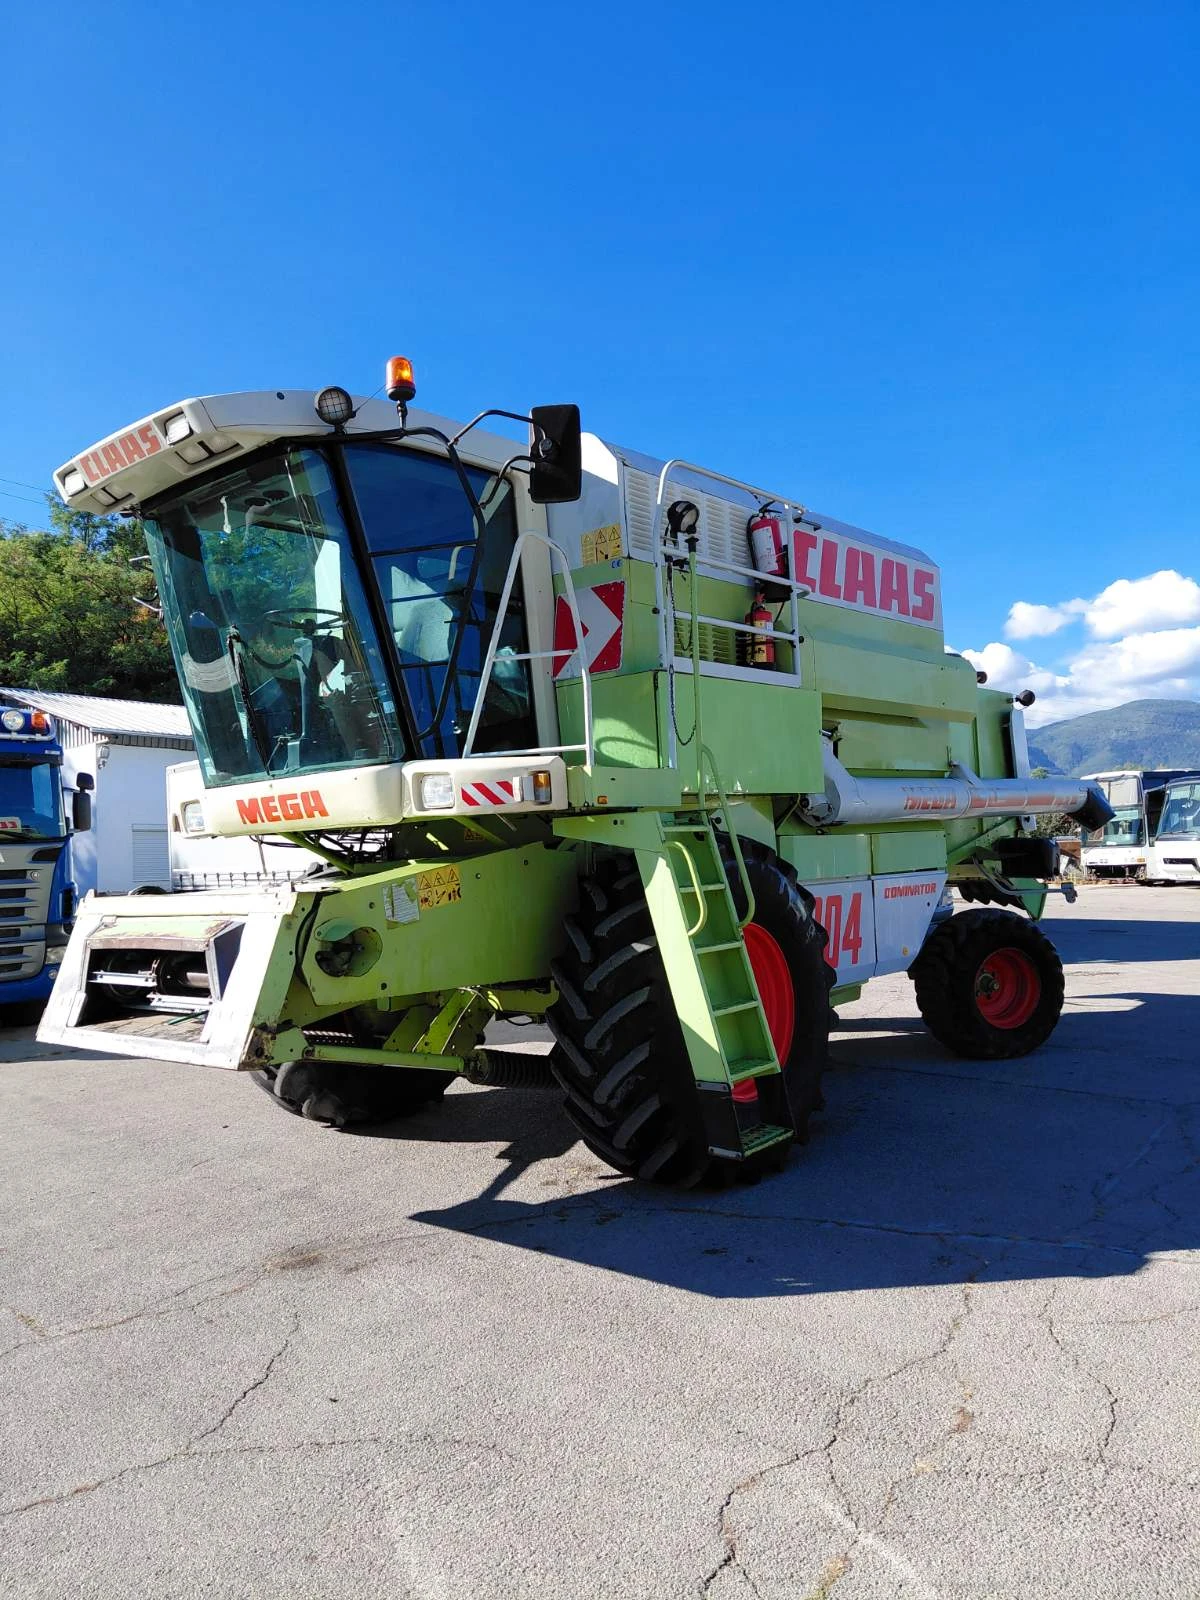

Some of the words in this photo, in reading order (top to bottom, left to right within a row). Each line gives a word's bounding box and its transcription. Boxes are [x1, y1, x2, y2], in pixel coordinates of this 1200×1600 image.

[79, 424, 161, 482] CLAAS
[793, 529, 935, 621] CLAAS
[236, 790, 330, 824] MEGA
[884, 883, 937, 899] DOMINATOR
